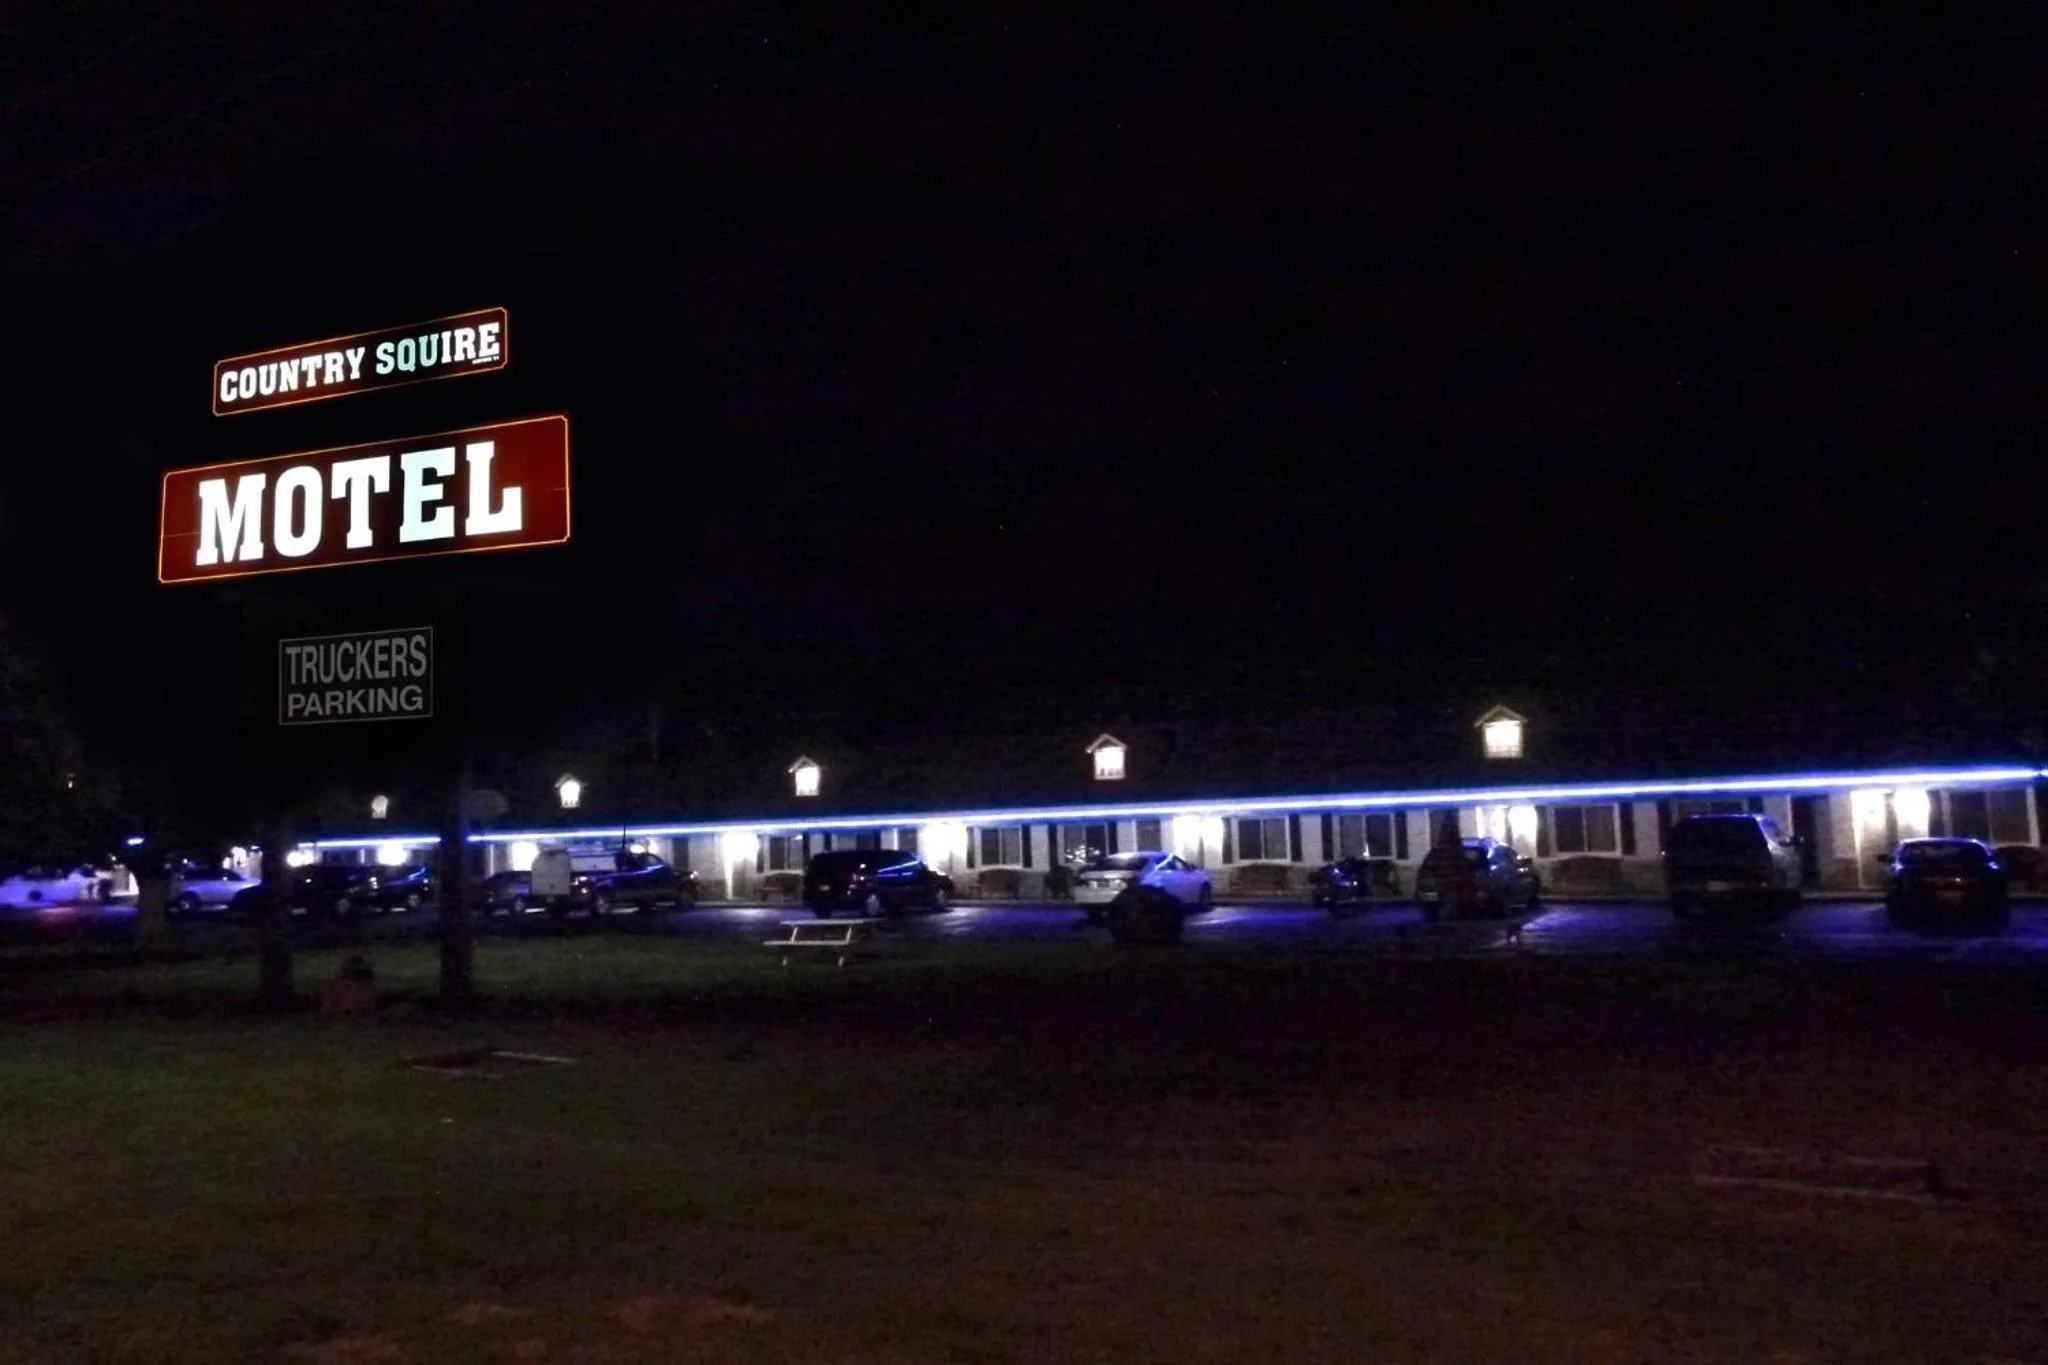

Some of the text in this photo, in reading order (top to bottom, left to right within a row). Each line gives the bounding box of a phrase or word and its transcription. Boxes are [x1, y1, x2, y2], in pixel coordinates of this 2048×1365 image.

[220, 322, 500, 402] COUNTRY SQUIRE
[196, 440, 523, 566] MOTEL
[285, 634, 427, 685] TRUCKERS
[287, 685, 423, 718] PARKING
